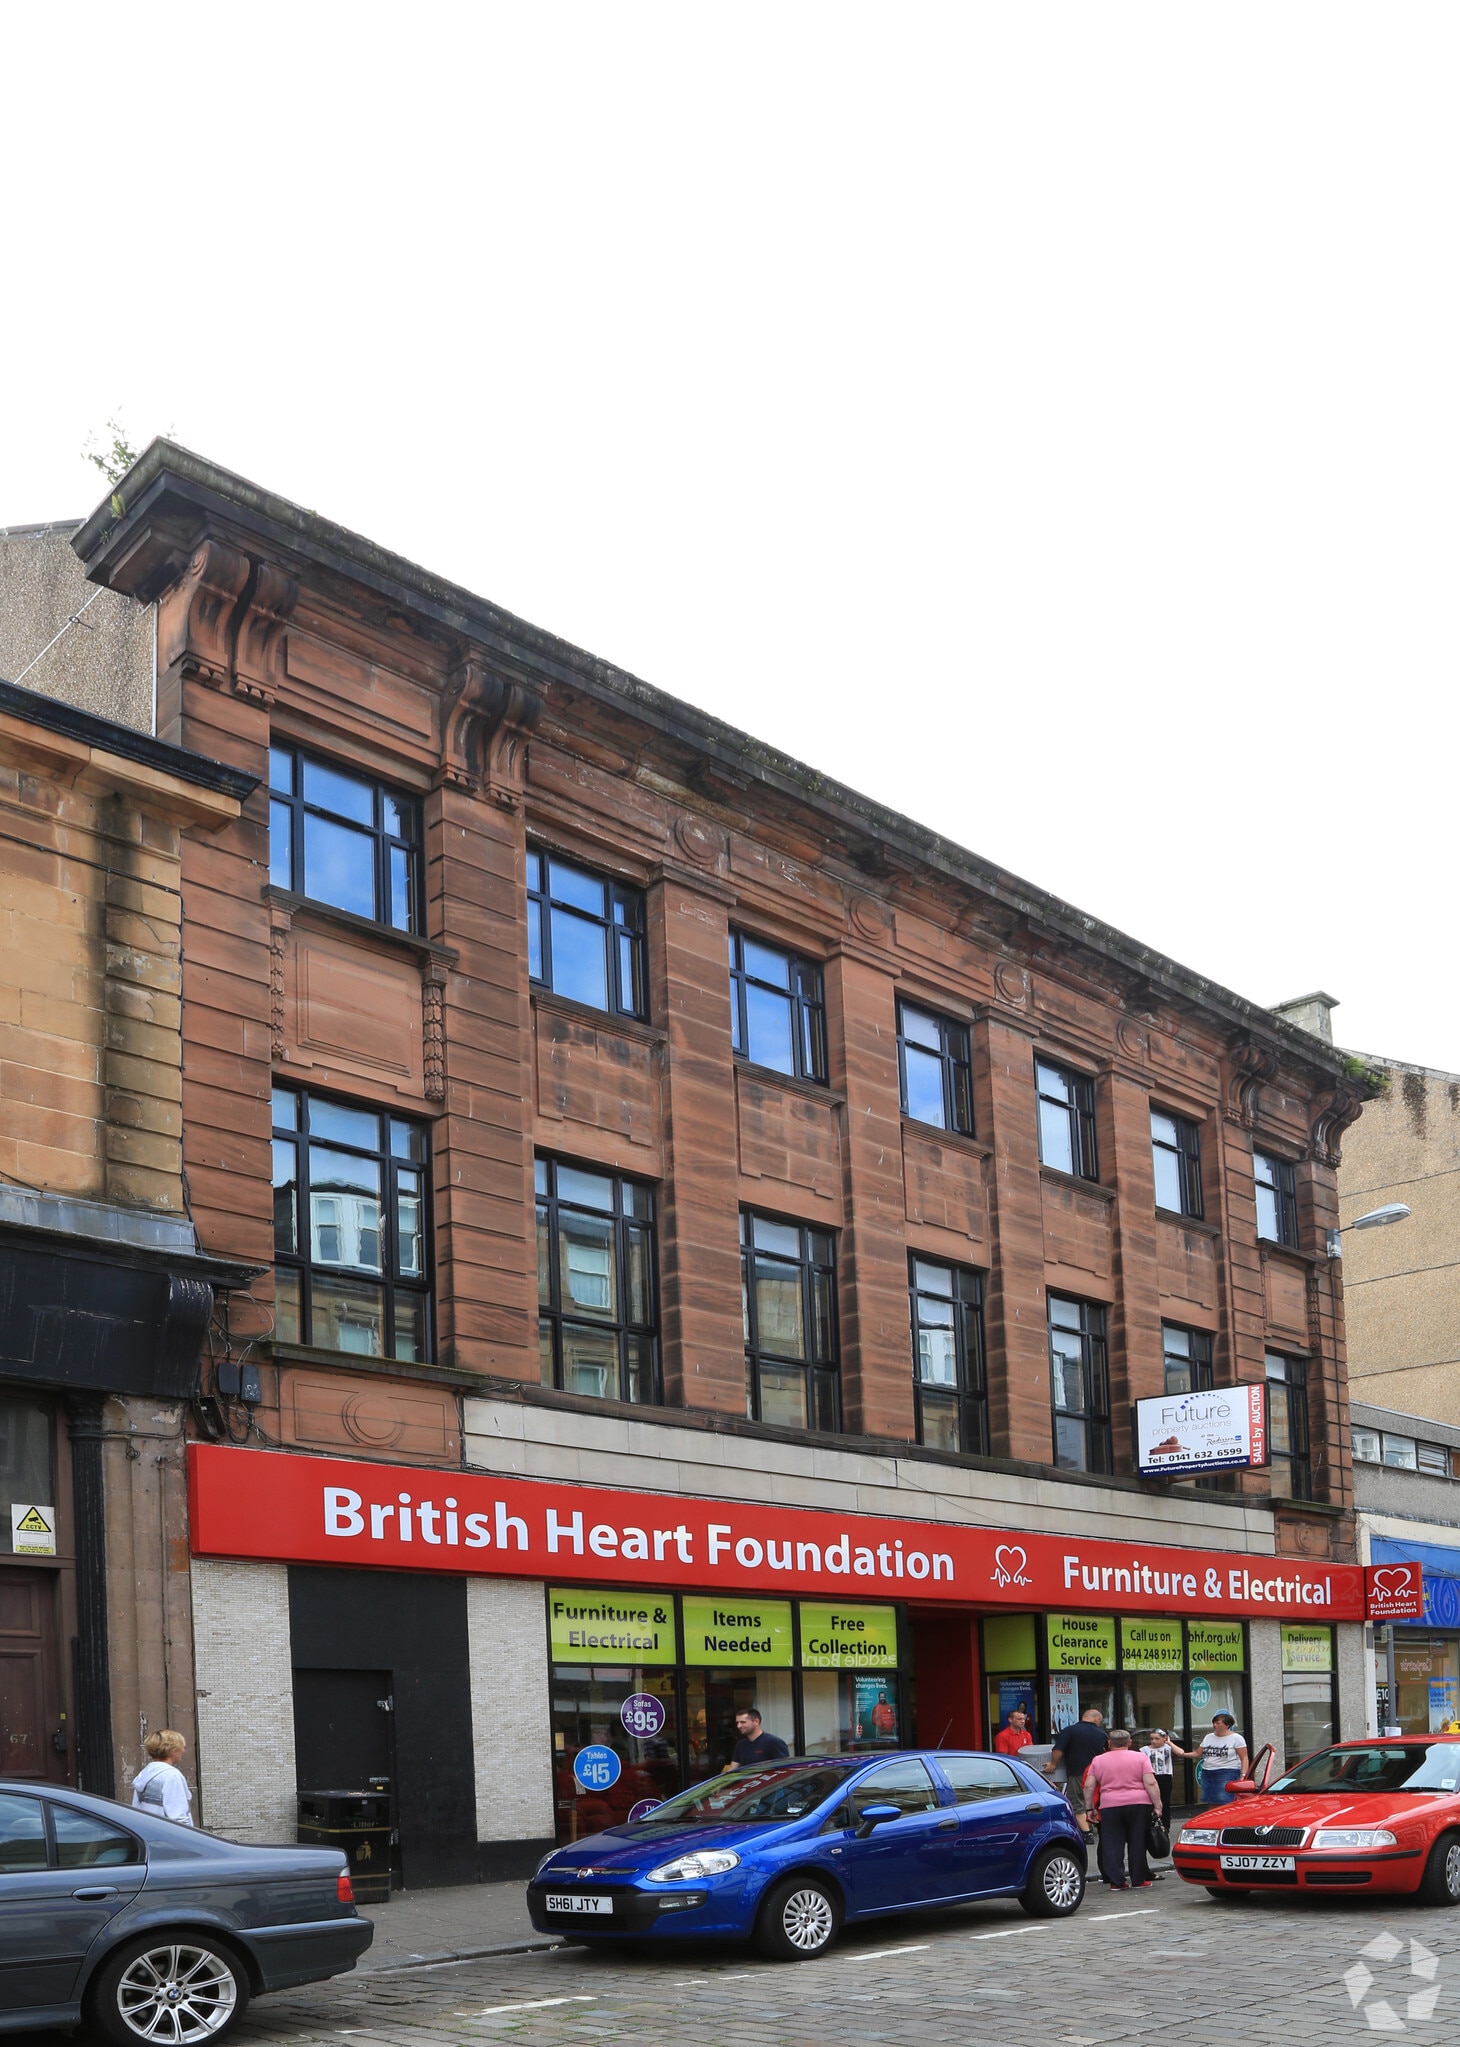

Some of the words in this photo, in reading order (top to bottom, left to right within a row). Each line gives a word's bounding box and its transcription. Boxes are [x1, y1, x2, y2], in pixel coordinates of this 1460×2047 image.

[1251, 1386, 1262, 1424] AUCTION
[1161, 1404, 1231, 1425] Future
[1152, 1425, 1190, 1437] property
[1191, 1420, 1231, 1430] auctions
[1253, 1428, 1263, 1439] by
[1148, 1454, 1164, 1464] Tel:
[1168, 1451, 1190, 1462] 0141
[1194, 1450, 1213, 1460] 632
[1217, 1448, 1242, 1457] 6599
[1253, 1441, 1263, 1463] SALE
[1143, 1458, 1247, 1474] www.FuturePropertyAuctions.co.uk
[323, 1486, 529, 1551] British
[546, 1508, 693, 1564] Heart
[707, 1524, 955, 1582] Foundation
[1063, 1555, 1198, 1598] Furniture
[1203, 1569, 1223, 1599] &
[1229, 1570, 1331, 1605] Electrical
[553, 1602, 648, 1624] Furniture
[652, 1606, 667, 1624] &
[713, 1610, 762, 1628] Items
[1370, 1607, 1417, 1616] Foundation
[831, 1616, 865, 1632] Free
[1062, 1617, 1098, 1632] House
[568, 1630, 659, 1650] Electrical
[1052, 1633, 1108, 1649] Clearance
[1130, 1629, 1147, 1642] Call
[1148, 1632, 1158, 1642] us
[1159, 1632, 1171, 1642] on
[1188, 1629, 1240, 1646] bhf.org.uk/
[1288, 1633, 1322, 1647] Delivery
[704, 1635, 772, 1653] Needed
[809, 1639, 887, 1656] Collection
[1060, 1652, 1102, 1667] Service
[1121, 1648, 1142, 1660] 0844
[1144, 1648, 1160, 1660] 248
[1161, 1648, 1182, 1660] 9127
[1192, 1649, 1238, 1662] collection
[1290, 1651, 1320, 1662] Service
[855, 1676, 886, 1684] Volunteering
[633, 1700, 651, 1708] Sofas
[1191, 1689, 1207, 1704] £40
[625, 1711, 658, 1731] £95
[10, 1733, 28, 1744] 67
[582, 1763, 610, 1784] £15
[1225, 1857, 1257, 1868] SJ07
[1261, 1857, 1288, 1868] ZZY
[549, 1897, 573, 1910] SH61
[576, 1898, 599, 1911] JTY
